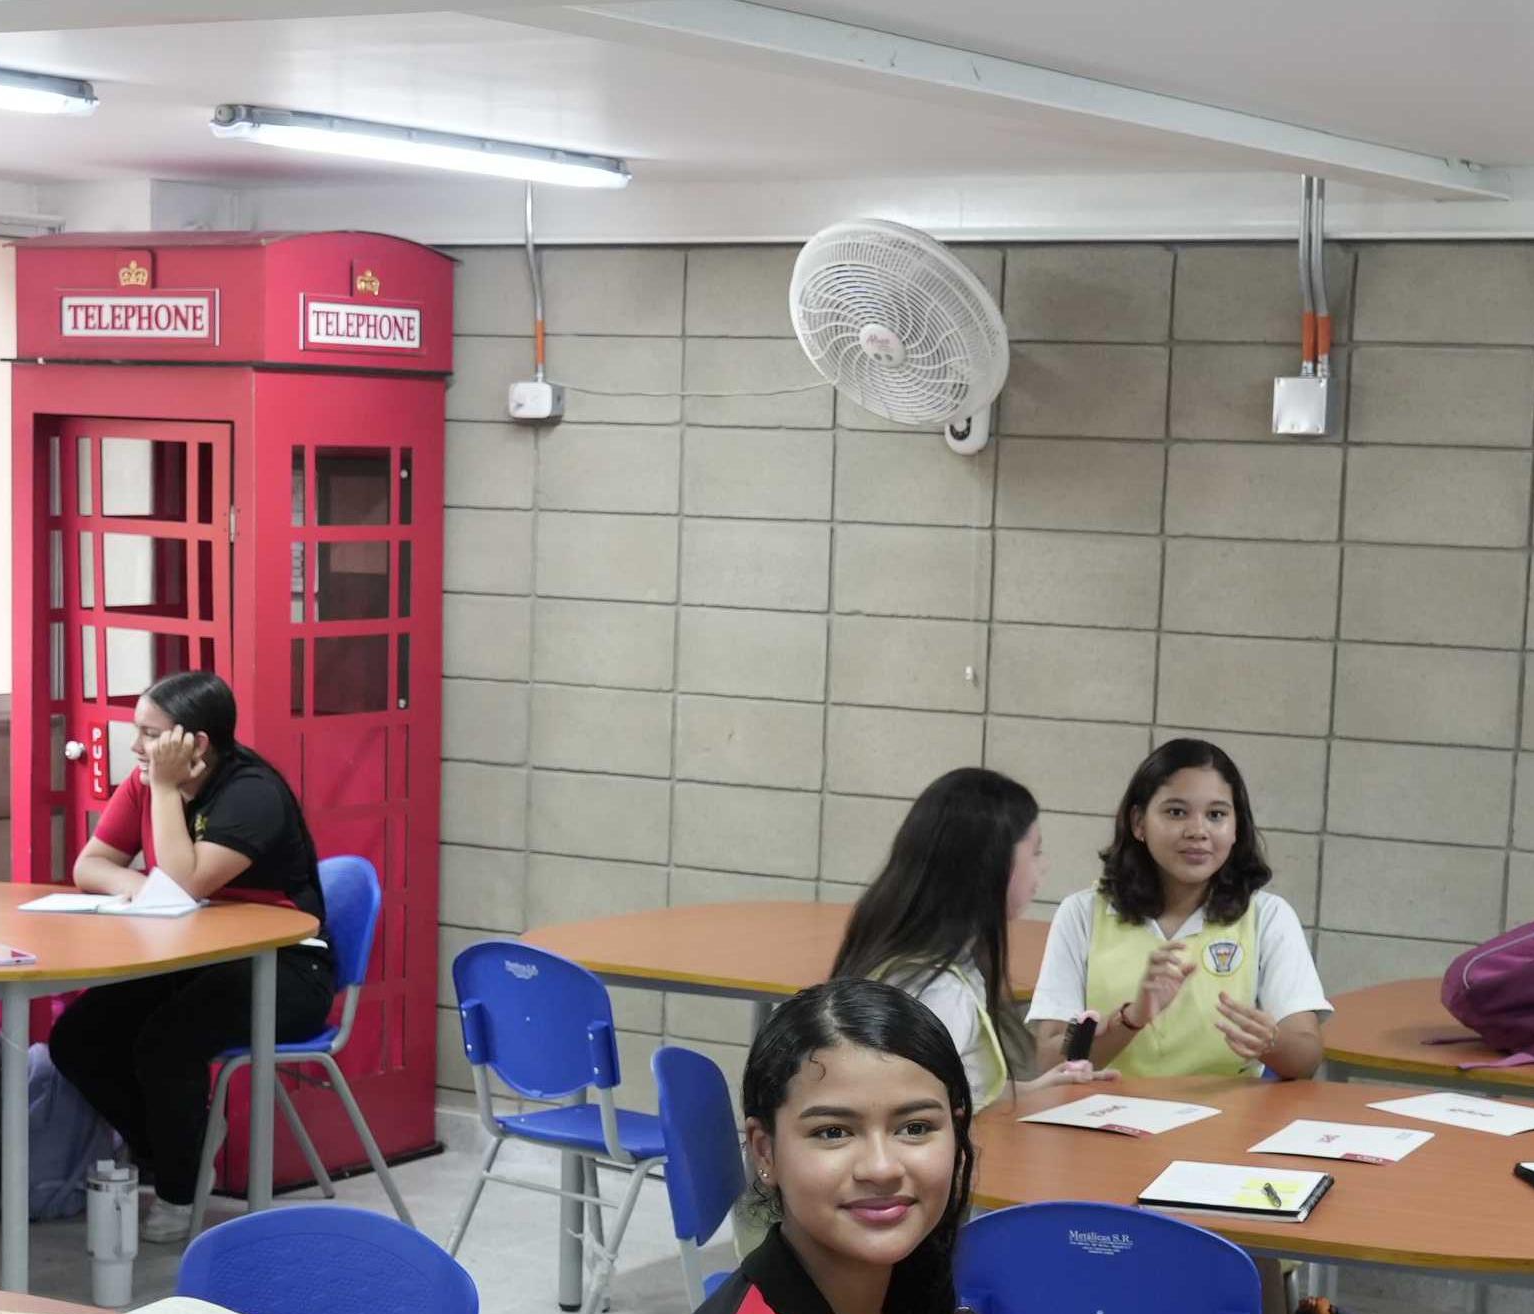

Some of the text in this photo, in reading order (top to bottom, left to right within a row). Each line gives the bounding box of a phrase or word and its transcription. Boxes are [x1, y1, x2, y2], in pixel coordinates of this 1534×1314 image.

[67, 304, 205, 332] TELEPHONE
[312, 310, 416, 342] TELEPHONE
[92, 727, 103, 793] PULL
